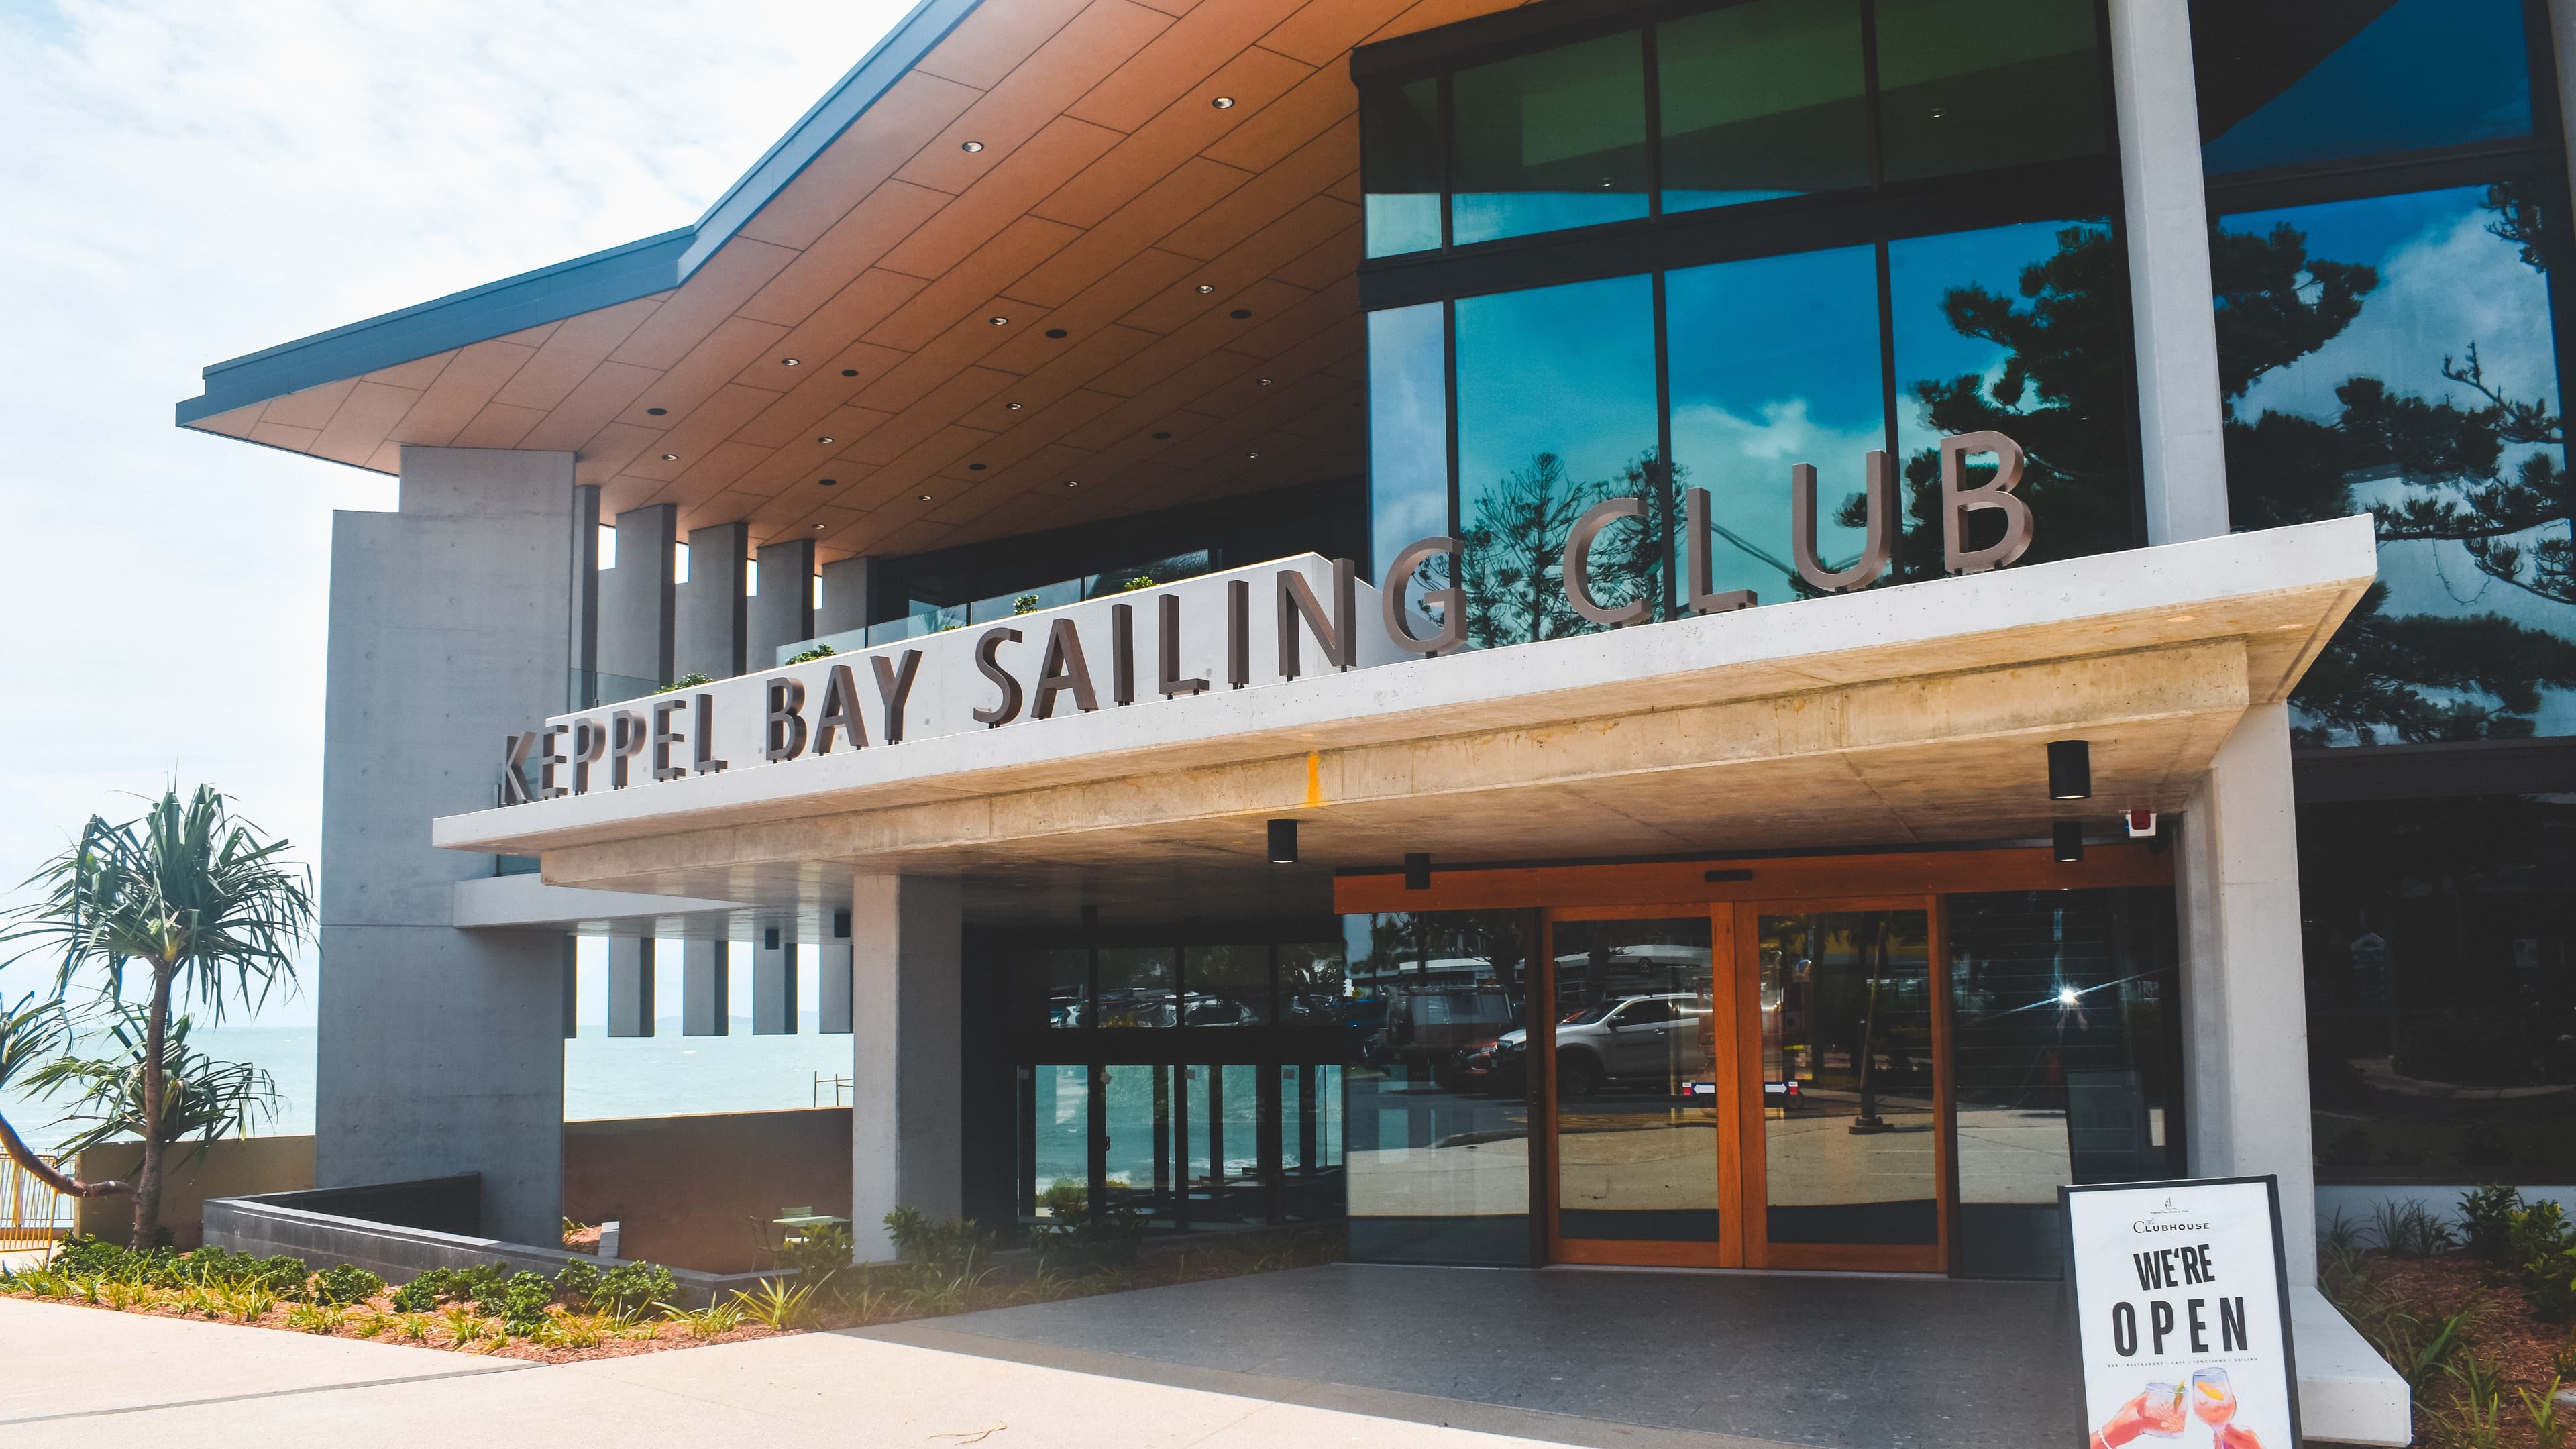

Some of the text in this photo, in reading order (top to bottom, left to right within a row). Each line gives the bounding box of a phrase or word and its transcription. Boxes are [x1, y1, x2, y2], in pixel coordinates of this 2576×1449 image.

[502, 430, 2033, 806] KEPPEL BAY SAILING CLUB
[2112, 1297, 2248, 1357] OPEN
